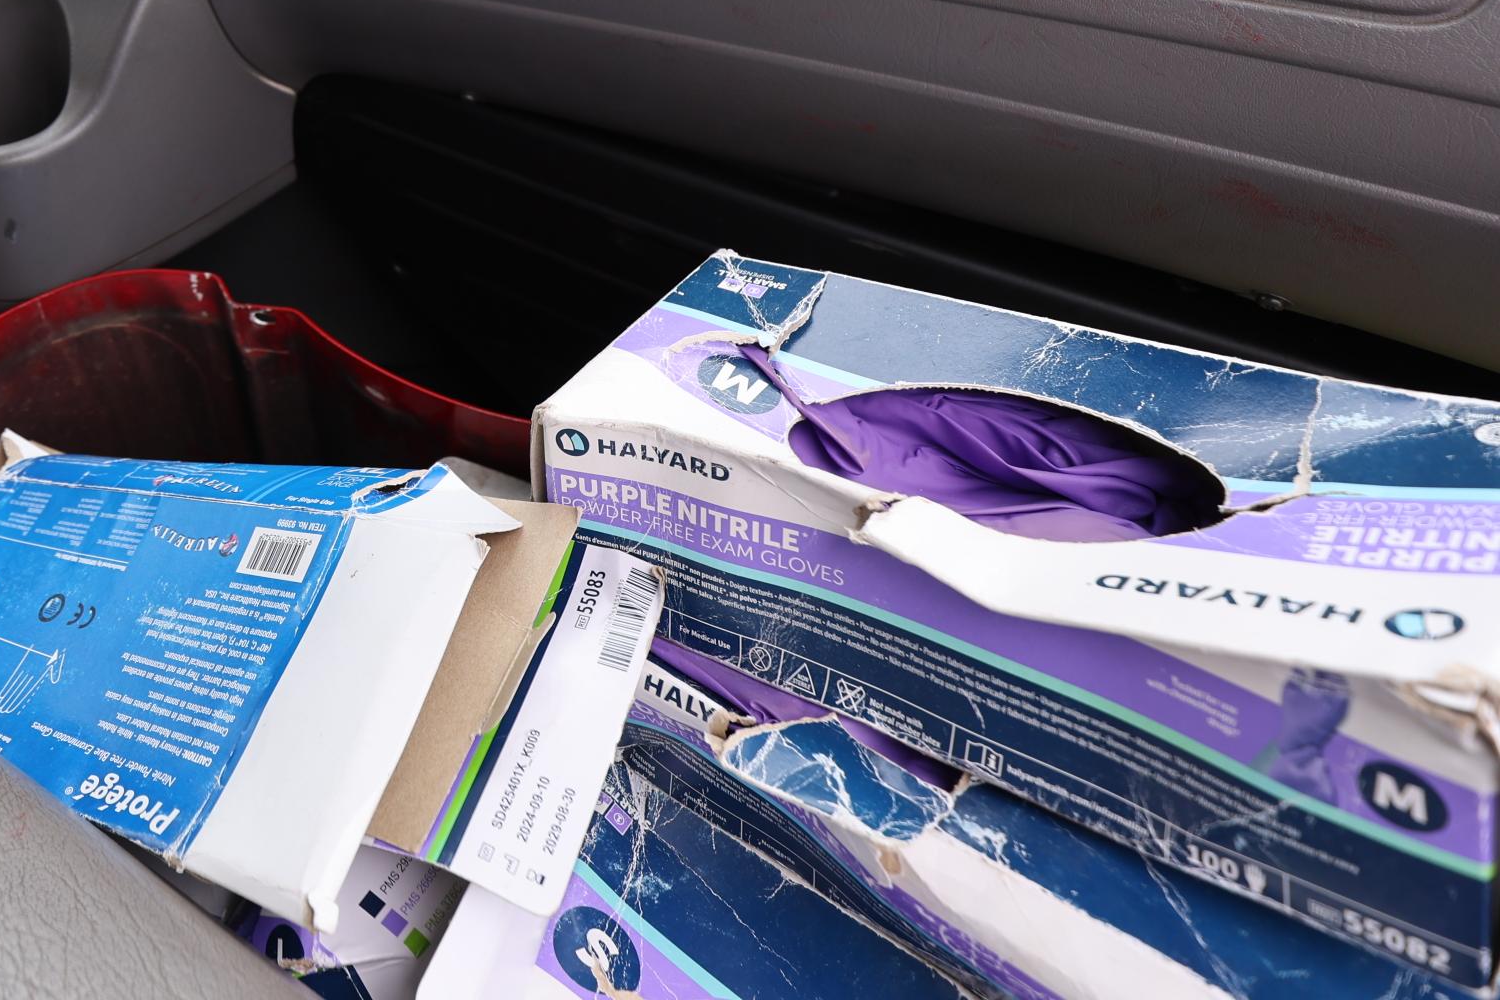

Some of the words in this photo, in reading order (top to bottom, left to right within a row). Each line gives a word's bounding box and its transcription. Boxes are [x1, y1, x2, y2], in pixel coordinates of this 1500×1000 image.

[711, 360, 769, 405] M
[597, 438, 731, 482] HALYARD
[560, 474, 671, 516] PURPLE
[1315, 501, 1426, 515] GLOVES
[1433, 502, 1500, 518] XAM
[1301, 511, 1500, 531] OWDER-FREE
[153, 522, 219, 552] AURELIA
[560, 495, 695, 543] POWDER-FREE
[701, 532, 755, 561] EXAM
[760, 550, 845, 586] GLOVES
[1302, 543, 1498, 573] PURPLE
[577, 569, 607, 616] 55083
[1094, 573, 1364, 625] HALYARD
[678, 624, 691, 635] For
[691, 626, 716, 644] Medical
[717, 637, 731, 650] Use
[244, 654, 265, 665] Store
[153, 674, 175, 685] provide
[184, 669, 200, 681] They
[171, 680, 194, 691] gloves
[161, 696, 180, 706] some
[206, 688, 229, 701] quality
[229, 695, 244, 707] High
[130, 699, 152, 711] gloves
[149, 704, 172, 717] making
[182, 702, 213, 715] reactions
[869, 697, 886, 711] Not
[168, 711, 178, 720] in
[176, 713, 192, 724] used
[31, 722, 53, 737] Gloves
[128, 718, 151, 731] Rubber
[146, 724, 172, 738] Natural
[191, 718, 229, 737] Components
[52, 731, 95, 755] Examination
[136, 734, 161, 748] Material
[167, 731, 193, 743] contain
[190, 737, 204, 747] not
[93, 748, 111, 762] Blue
[155, 740, 183, 756] Primary
[202, 741, 220, 754] Does
[110, 754, 126, 768] Free
[181, 749, 212, 767] CAUTION:
[125, 760, 152, 778] Powder
[152, 770, 176, 787] Nitrile
[1372, 770, 1429, 826] M
[516, 775, 552, 844] 2024-09-10
[542, 786, 578, 857] 2029-08-30
[1186, 843, 1240, 881] 100
[380, 868, 400, 895] PMS
[400, 893, 421, 916] PMS
[424, 911, 446, 934] PMS
[1342, 908, 1452, 974] 55082
[575, 928, 619, 974] S
